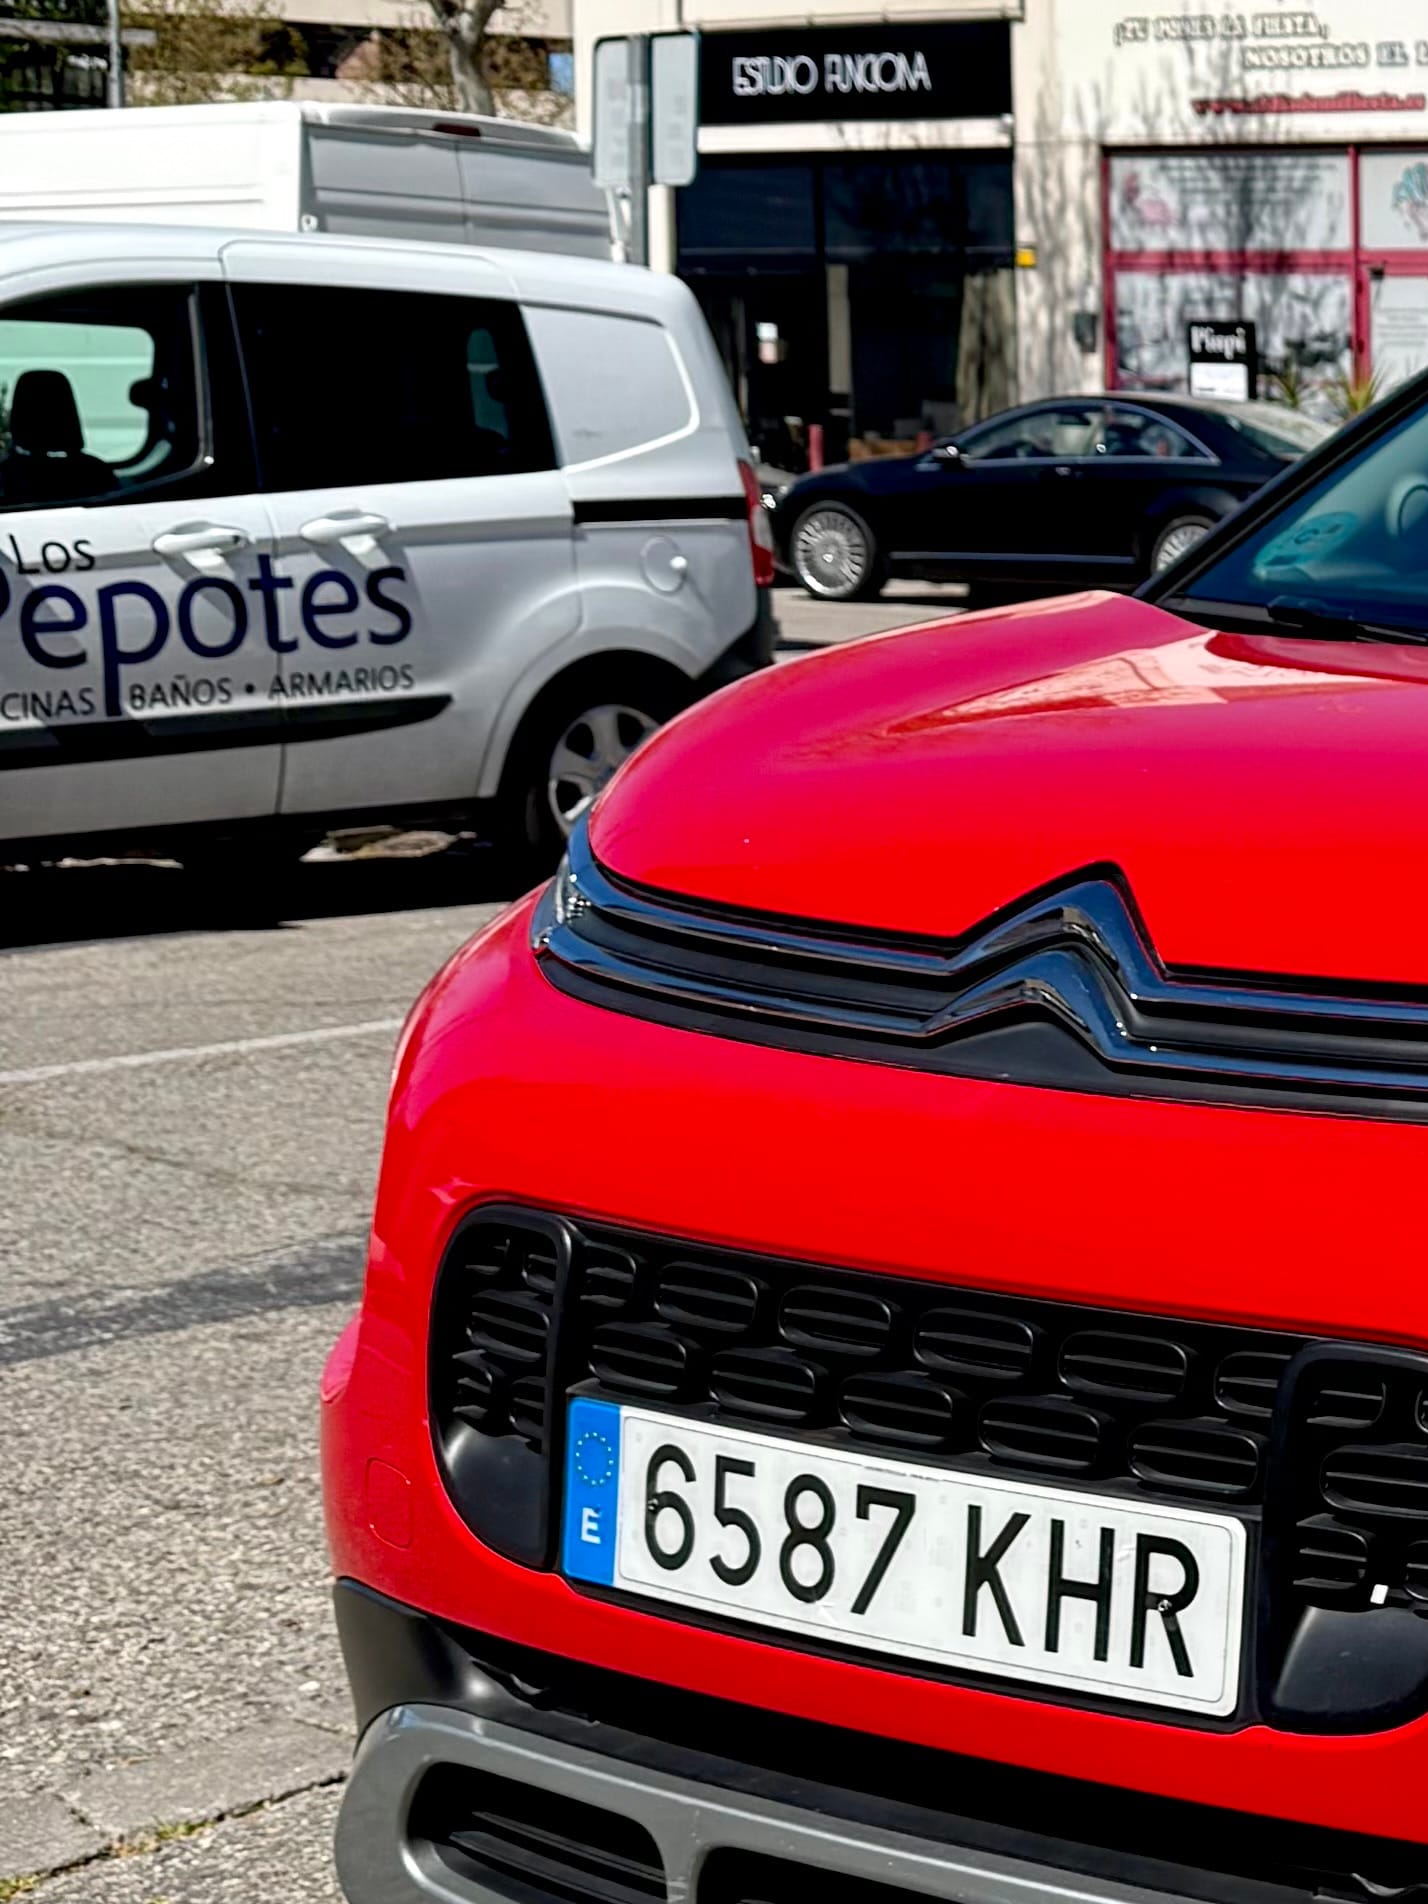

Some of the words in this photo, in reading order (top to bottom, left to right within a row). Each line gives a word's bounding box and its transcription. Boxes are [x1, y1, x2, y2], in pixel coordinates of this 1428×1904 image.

[0, 687, 96, 721] CINAS
[129, 674, 234, 711] BAÑOS
[268, 664, 415, 701] ARMARIOS
[581, 1507, 602, 1545] E
[644, 1444, 916, 1615] 6587
[961, 1504, 1200, 1678] KHR
